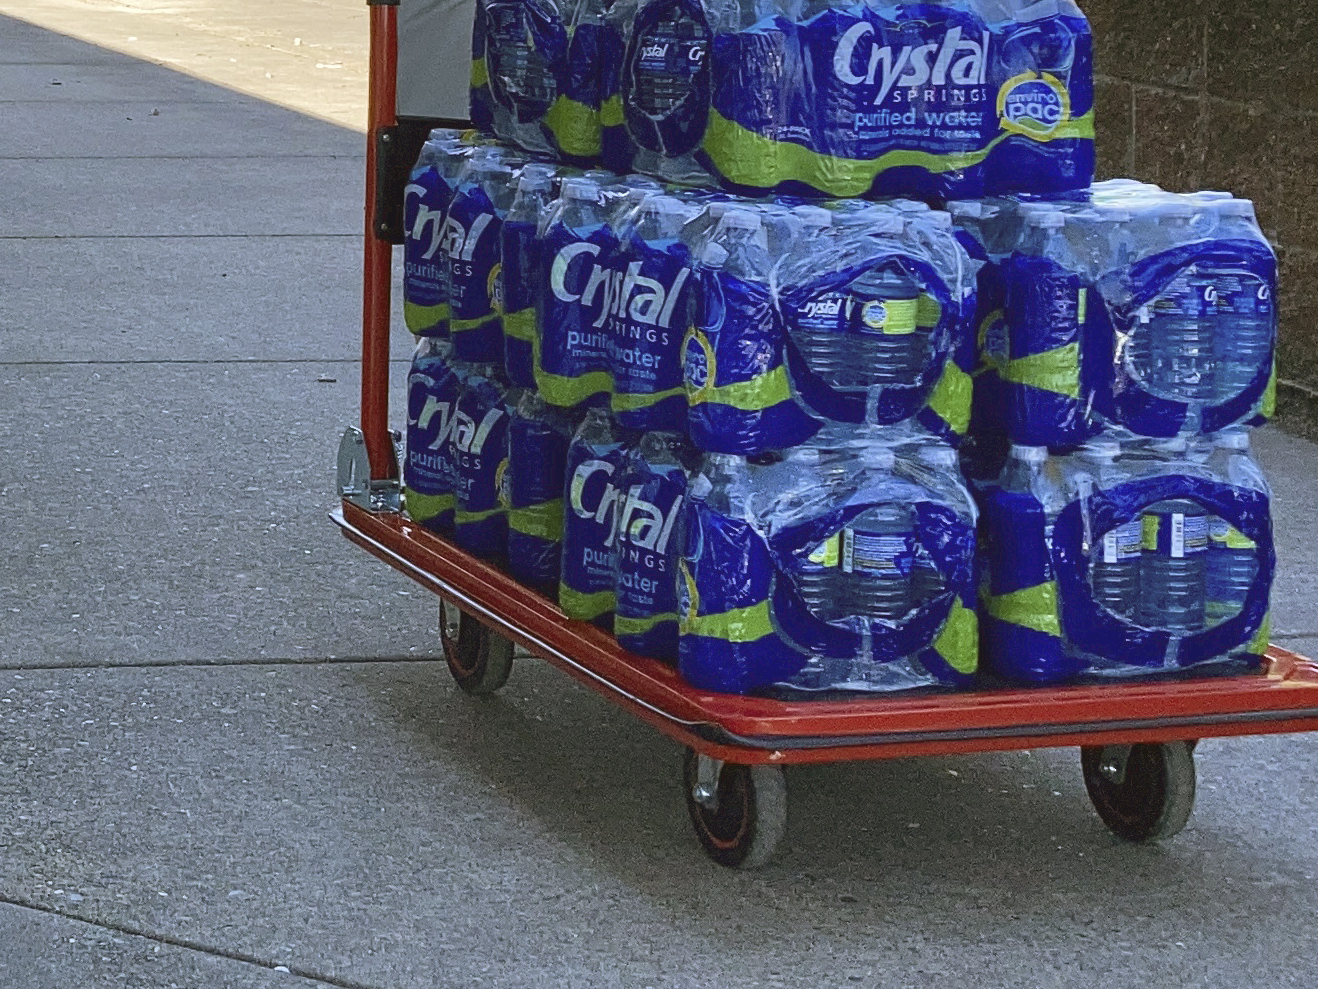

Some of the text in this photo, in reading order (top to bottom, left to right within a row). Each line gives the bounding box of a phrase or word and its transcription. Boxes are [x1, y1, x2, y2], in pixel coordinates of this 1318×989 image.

[834, 22, 991, 105] Crystal
[1007, 89, 1057, 104] enviro
[854, 108, 983, 131] purified wate
[1009, 102, 1061, 122] pac
[618, 347, 661, 368] ater
[619, 572, 659, 593] ater
